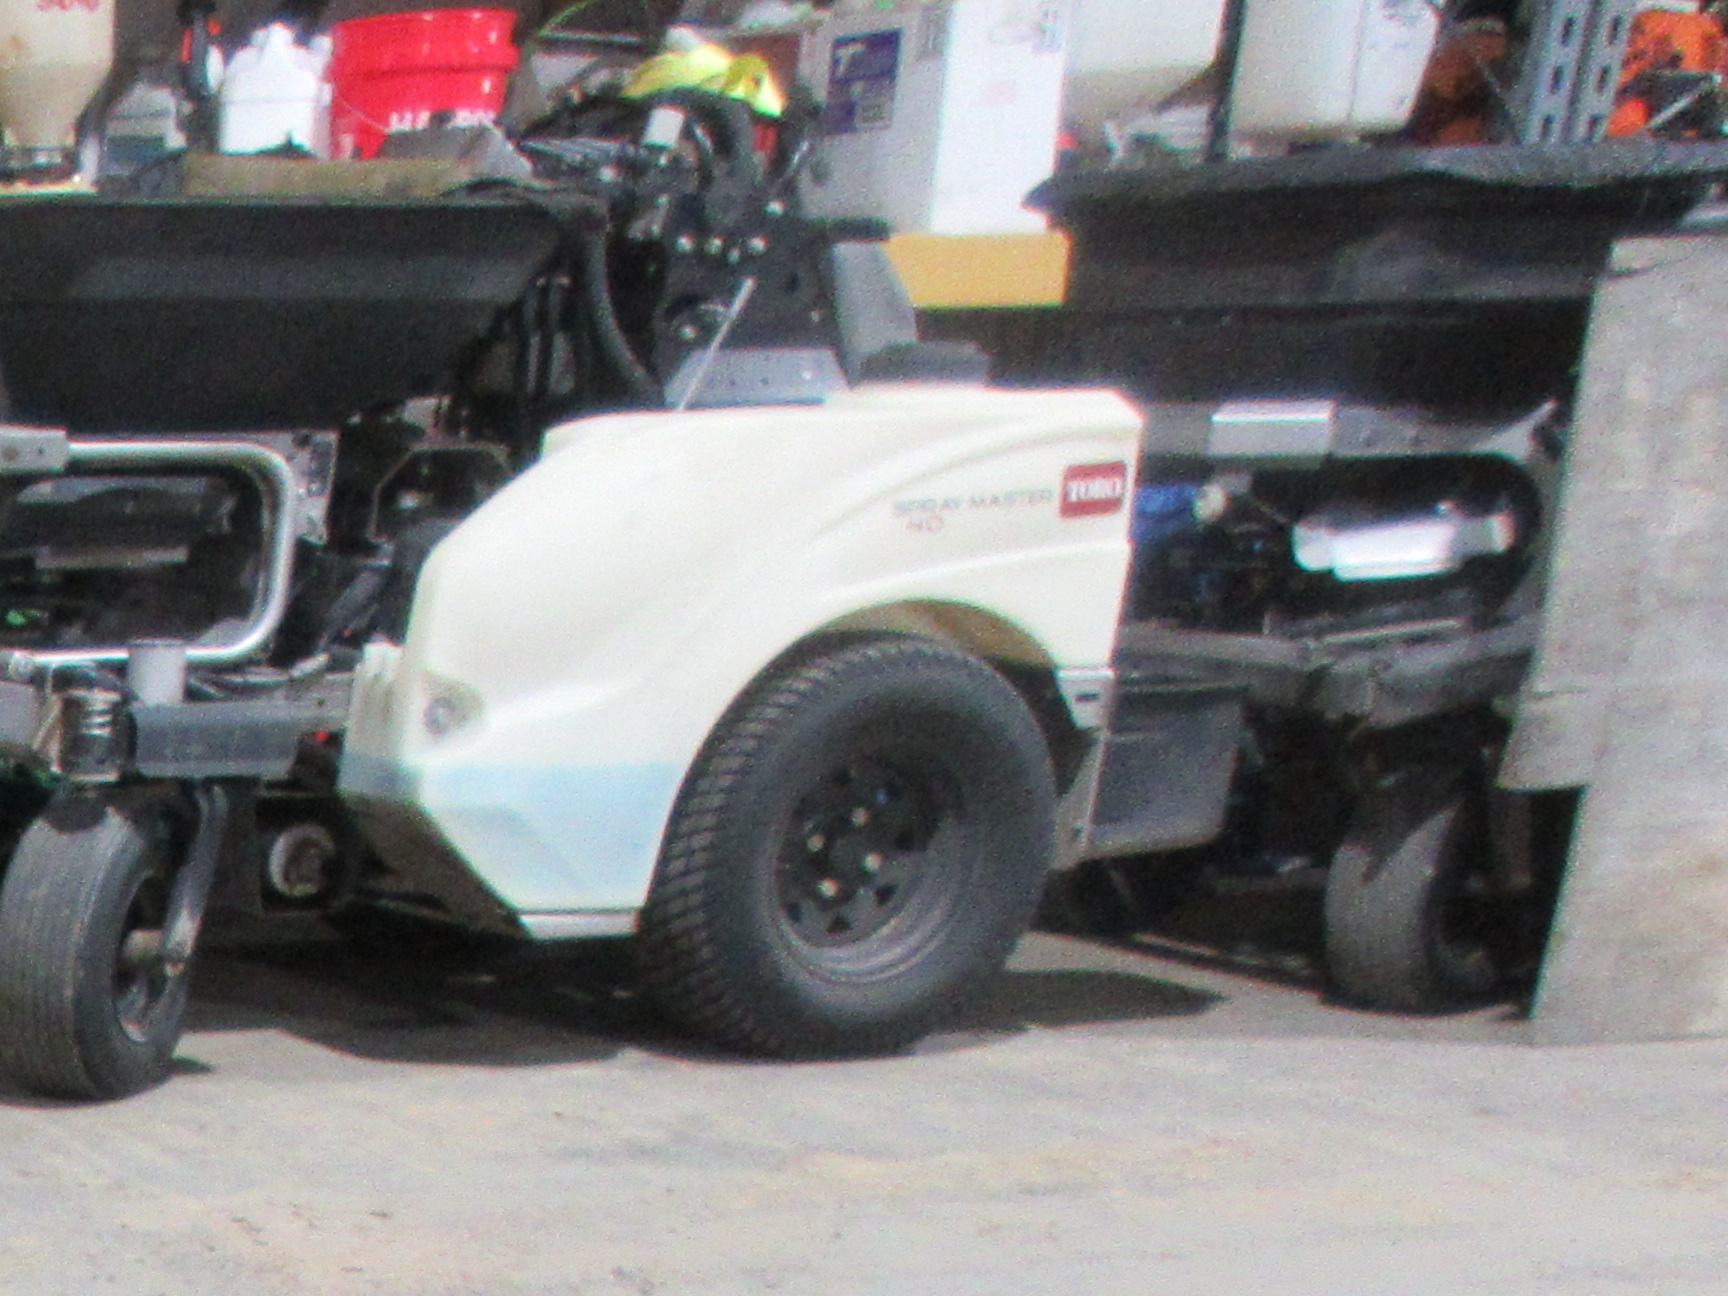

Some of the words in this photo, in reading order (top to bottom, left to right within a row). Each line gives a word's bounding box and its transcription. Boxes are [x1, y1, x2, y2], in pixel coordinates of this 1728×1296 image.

[895, 497, 961, 515] SPRAY
[969, 488, 1053, 508] MASTER
[1066, 478, 1122, 503] TORO
